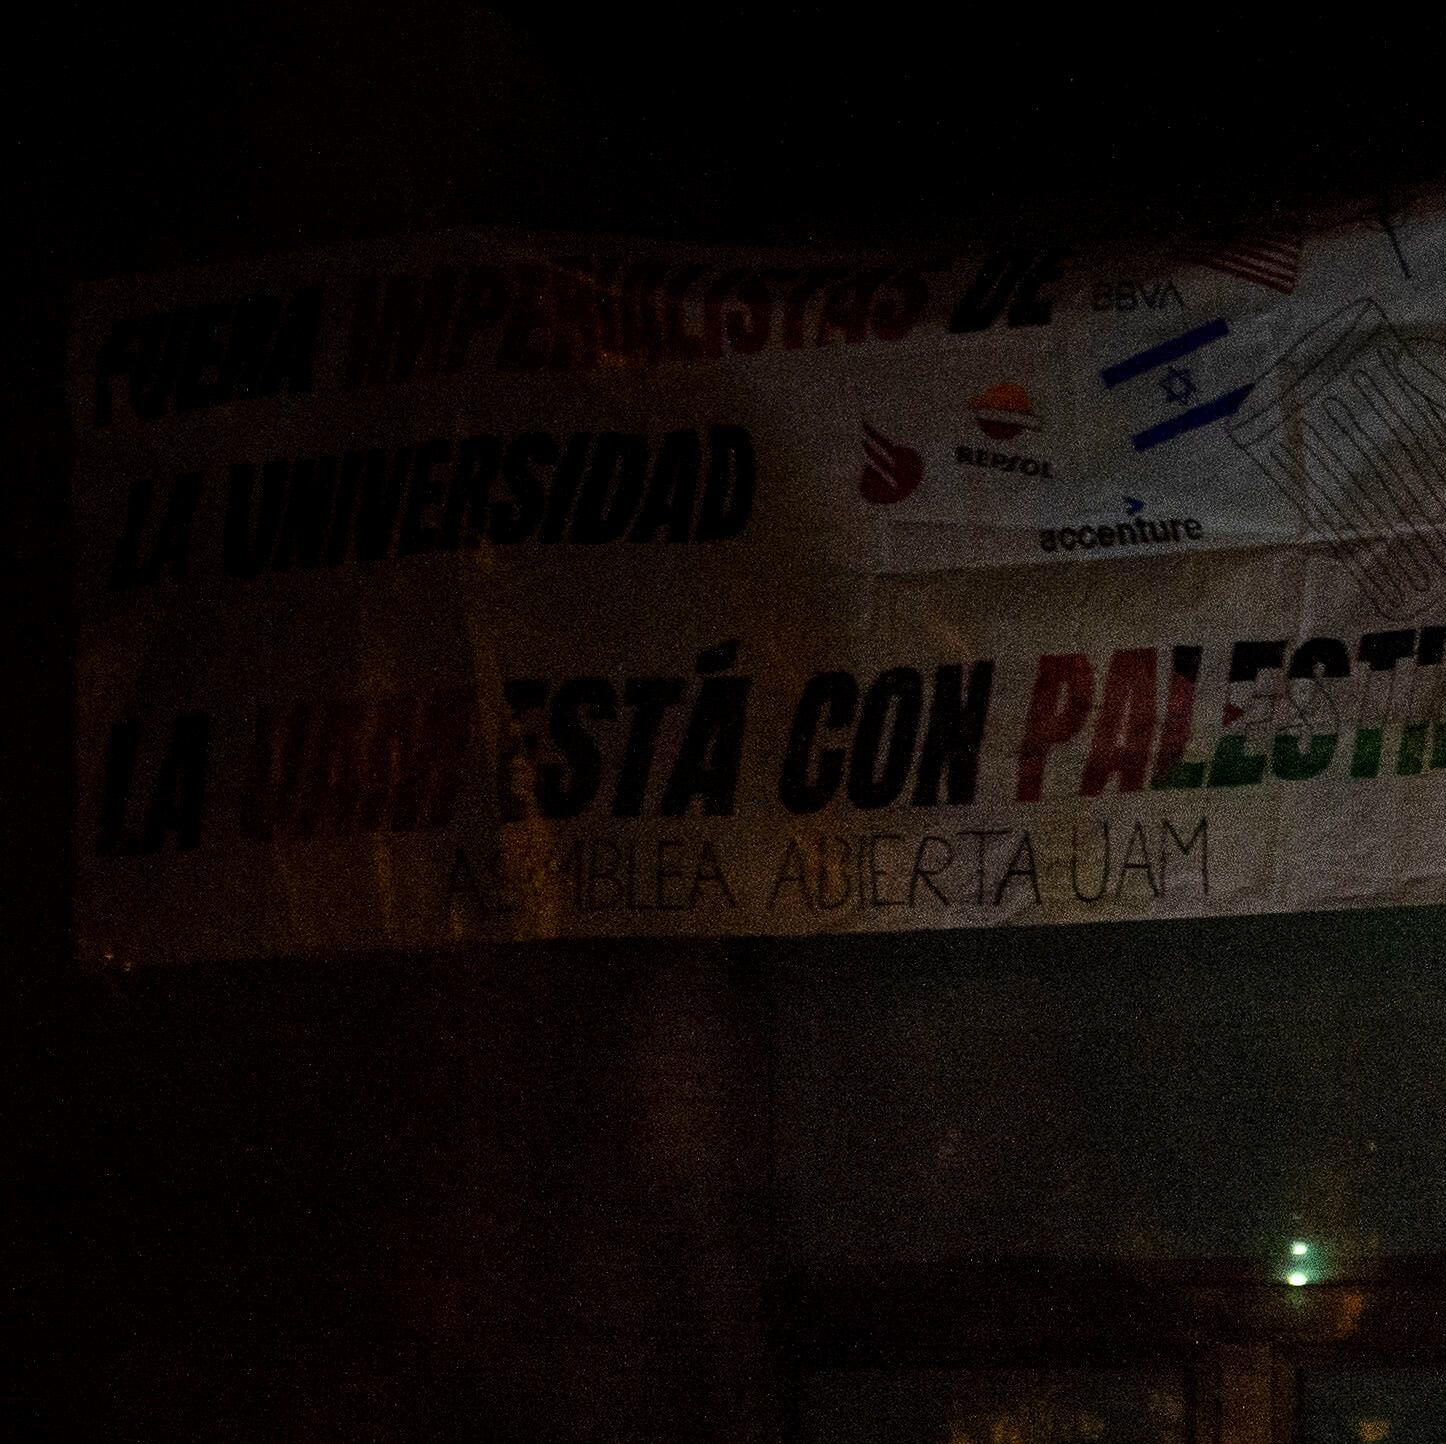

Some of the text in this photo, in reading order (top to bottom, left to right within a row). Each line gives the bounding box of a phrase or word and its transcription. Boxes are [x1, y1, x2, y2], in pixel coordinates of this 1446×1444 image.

[97, 248, 1066, 428] FUERA IMPERIALISTAS DE
[1092, 280, 1186, 312] BBVA
[110, 424, 756, 592] LA UNIVERSIDAD
[955, 446, 1054, 479] REPSOL
[1039, 516, 1204, 553] accenture
[97, 713, 210, 857] LA
[498, 638, 753, 822] ESTÁ
[777, 660, 996, 814] CON
[767, 826, 1045, 913] ABIERTA
[1071, 816, 1210, 907] UAM
